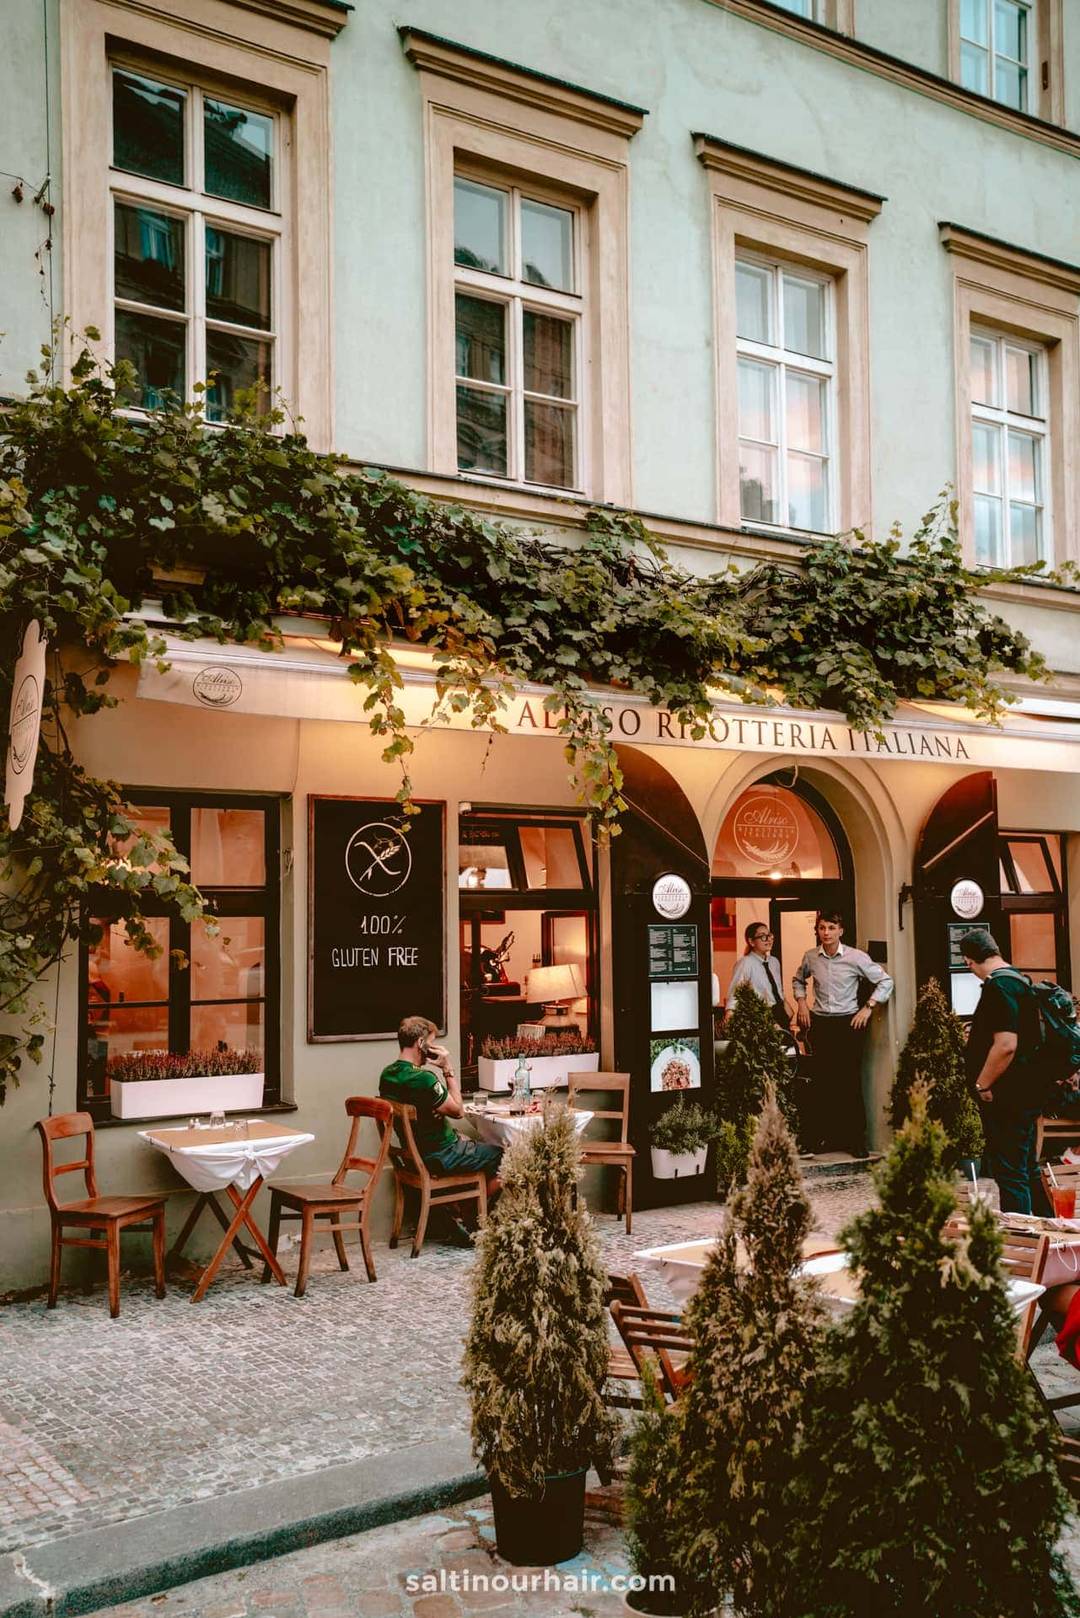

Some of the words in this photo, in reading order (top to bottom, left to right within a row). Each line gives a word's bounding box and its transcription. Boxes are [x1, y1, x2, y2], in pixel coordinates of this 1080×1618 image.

[656, 711, 838, 751] RIOTTERIA
[360, 915, 407, 934] 100%
[331, 947, 379, 967] GLUTEN
[388, 946, 419, 967] FREE
